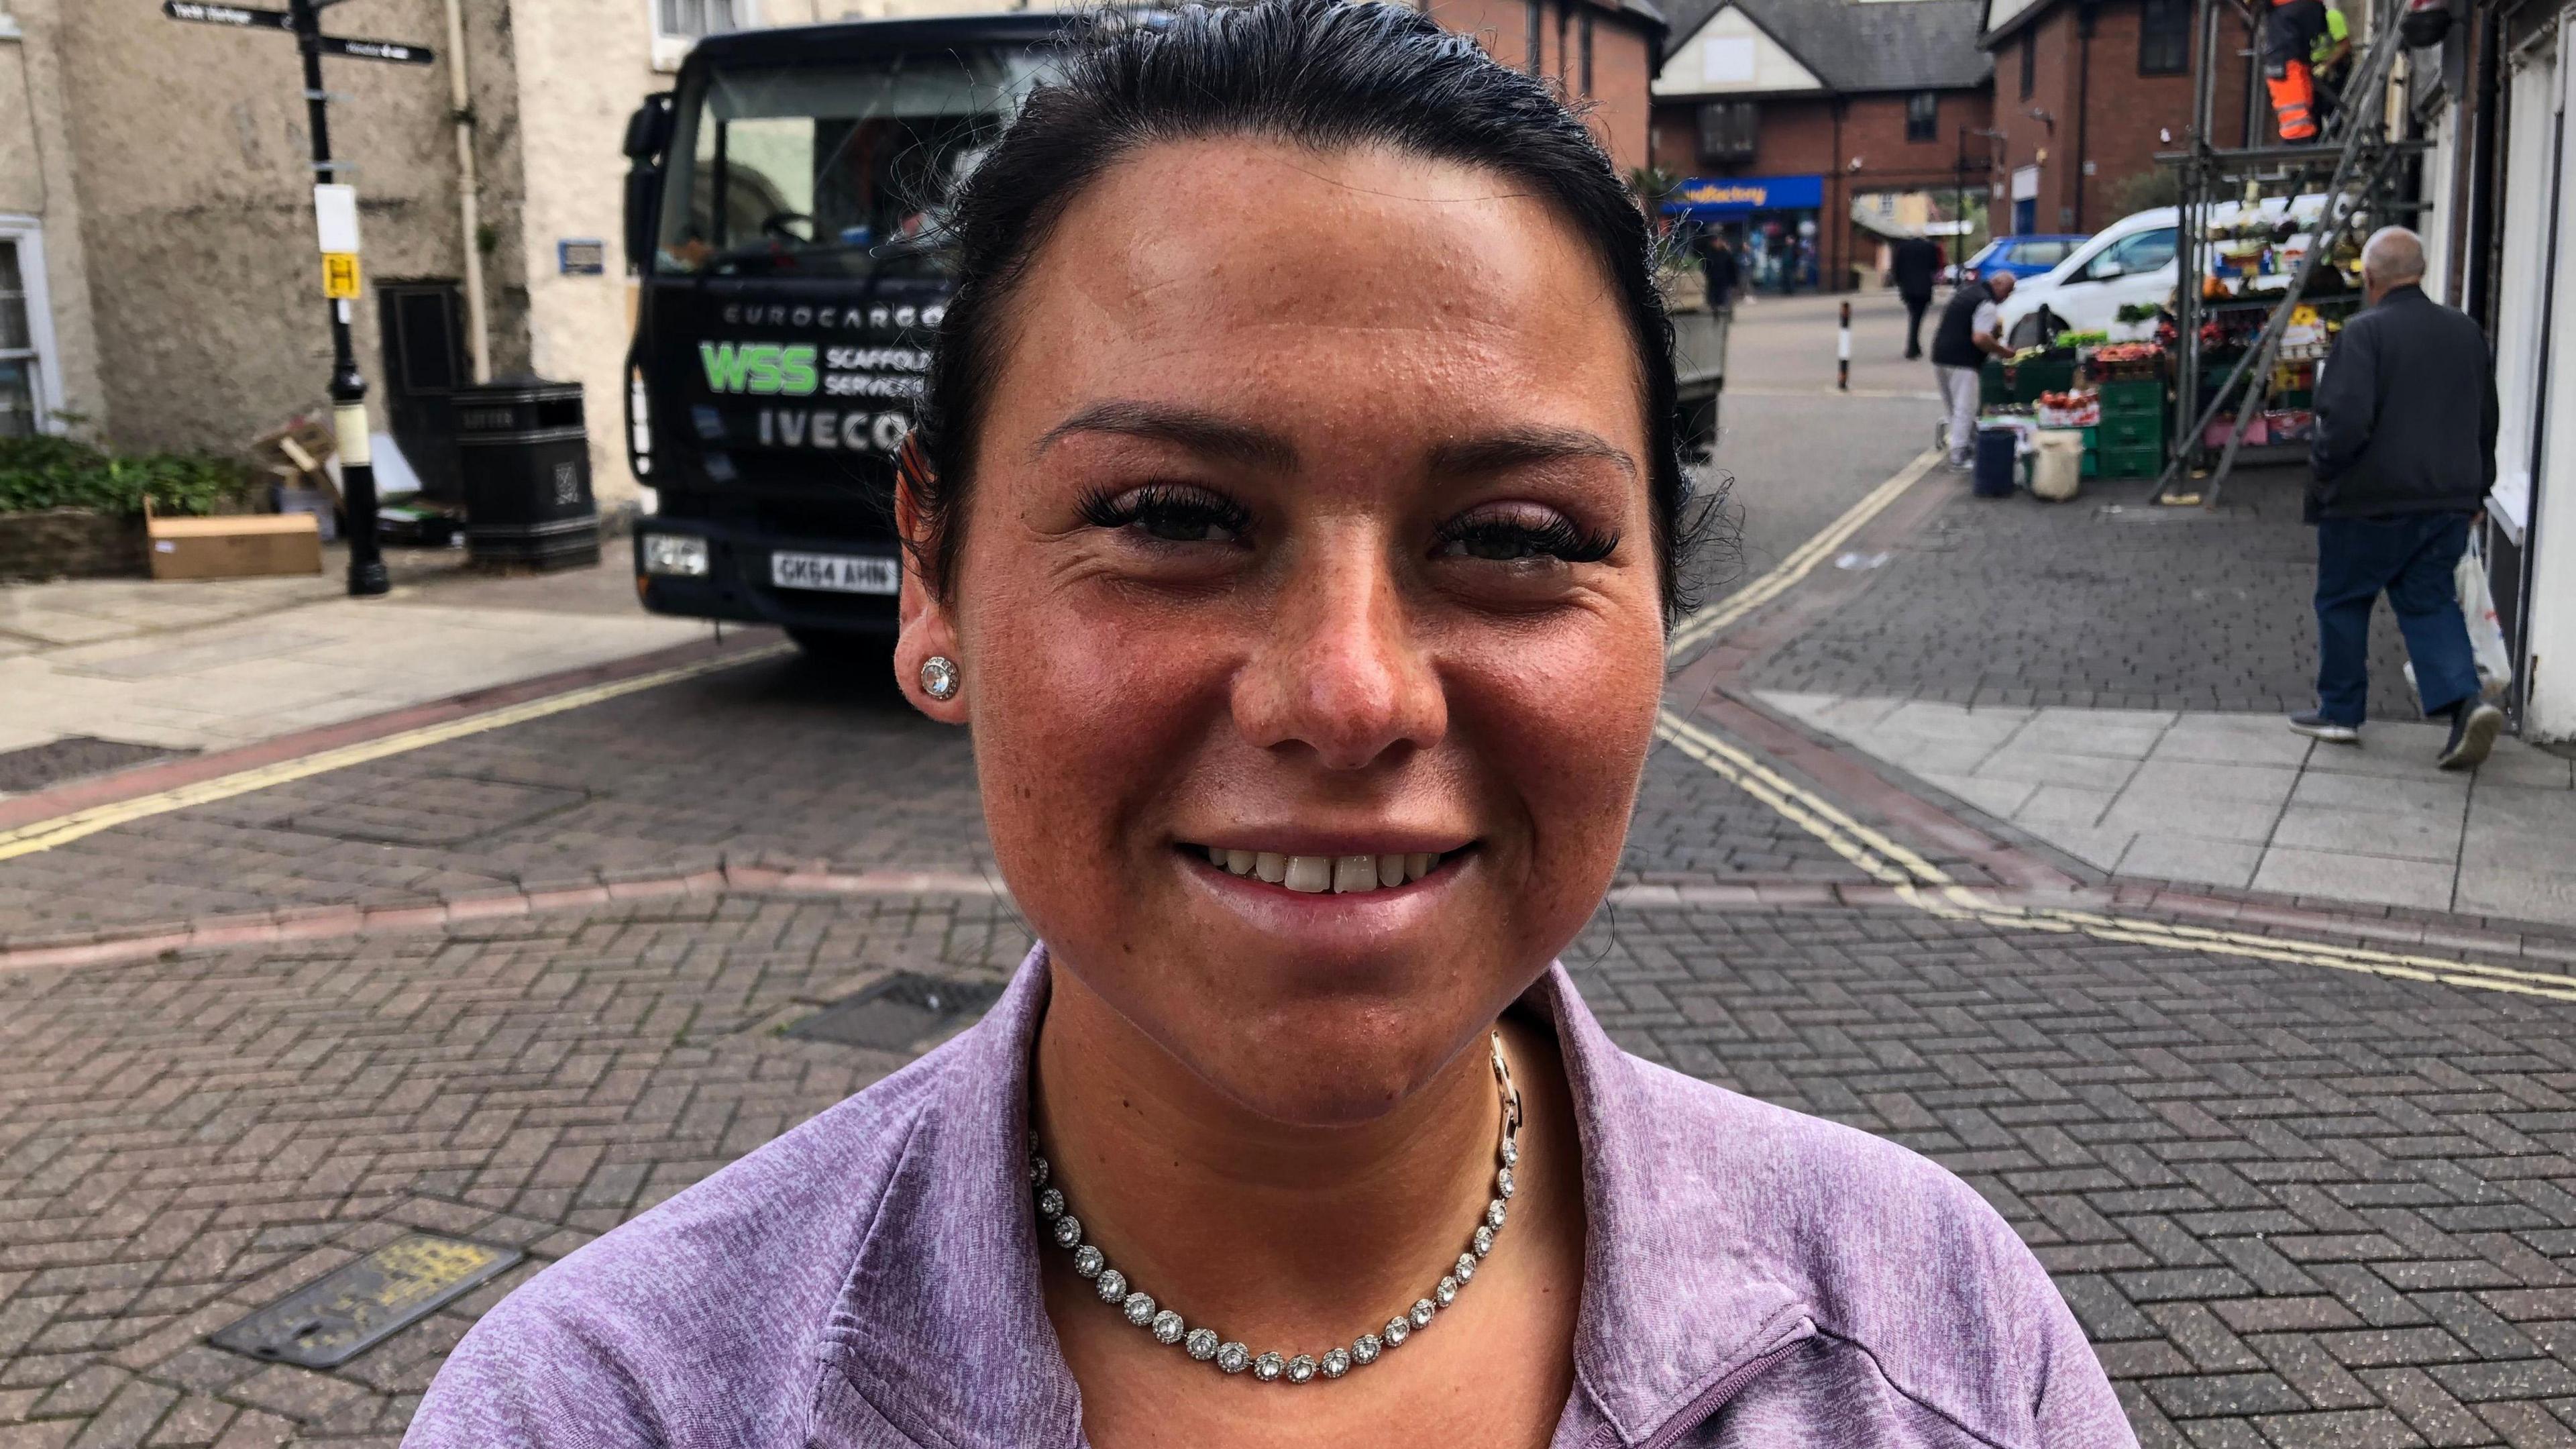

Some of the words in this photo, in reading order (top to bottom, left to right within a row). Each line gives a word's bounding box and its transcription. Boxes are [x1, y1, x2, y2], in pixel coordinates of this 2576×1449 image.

[330, 258, 354, 292] H
[722, 304, 945, 328] EUROCARGO
[698, 341, 818, 395] WSS
[759, 408, 910, 451] IVECO
